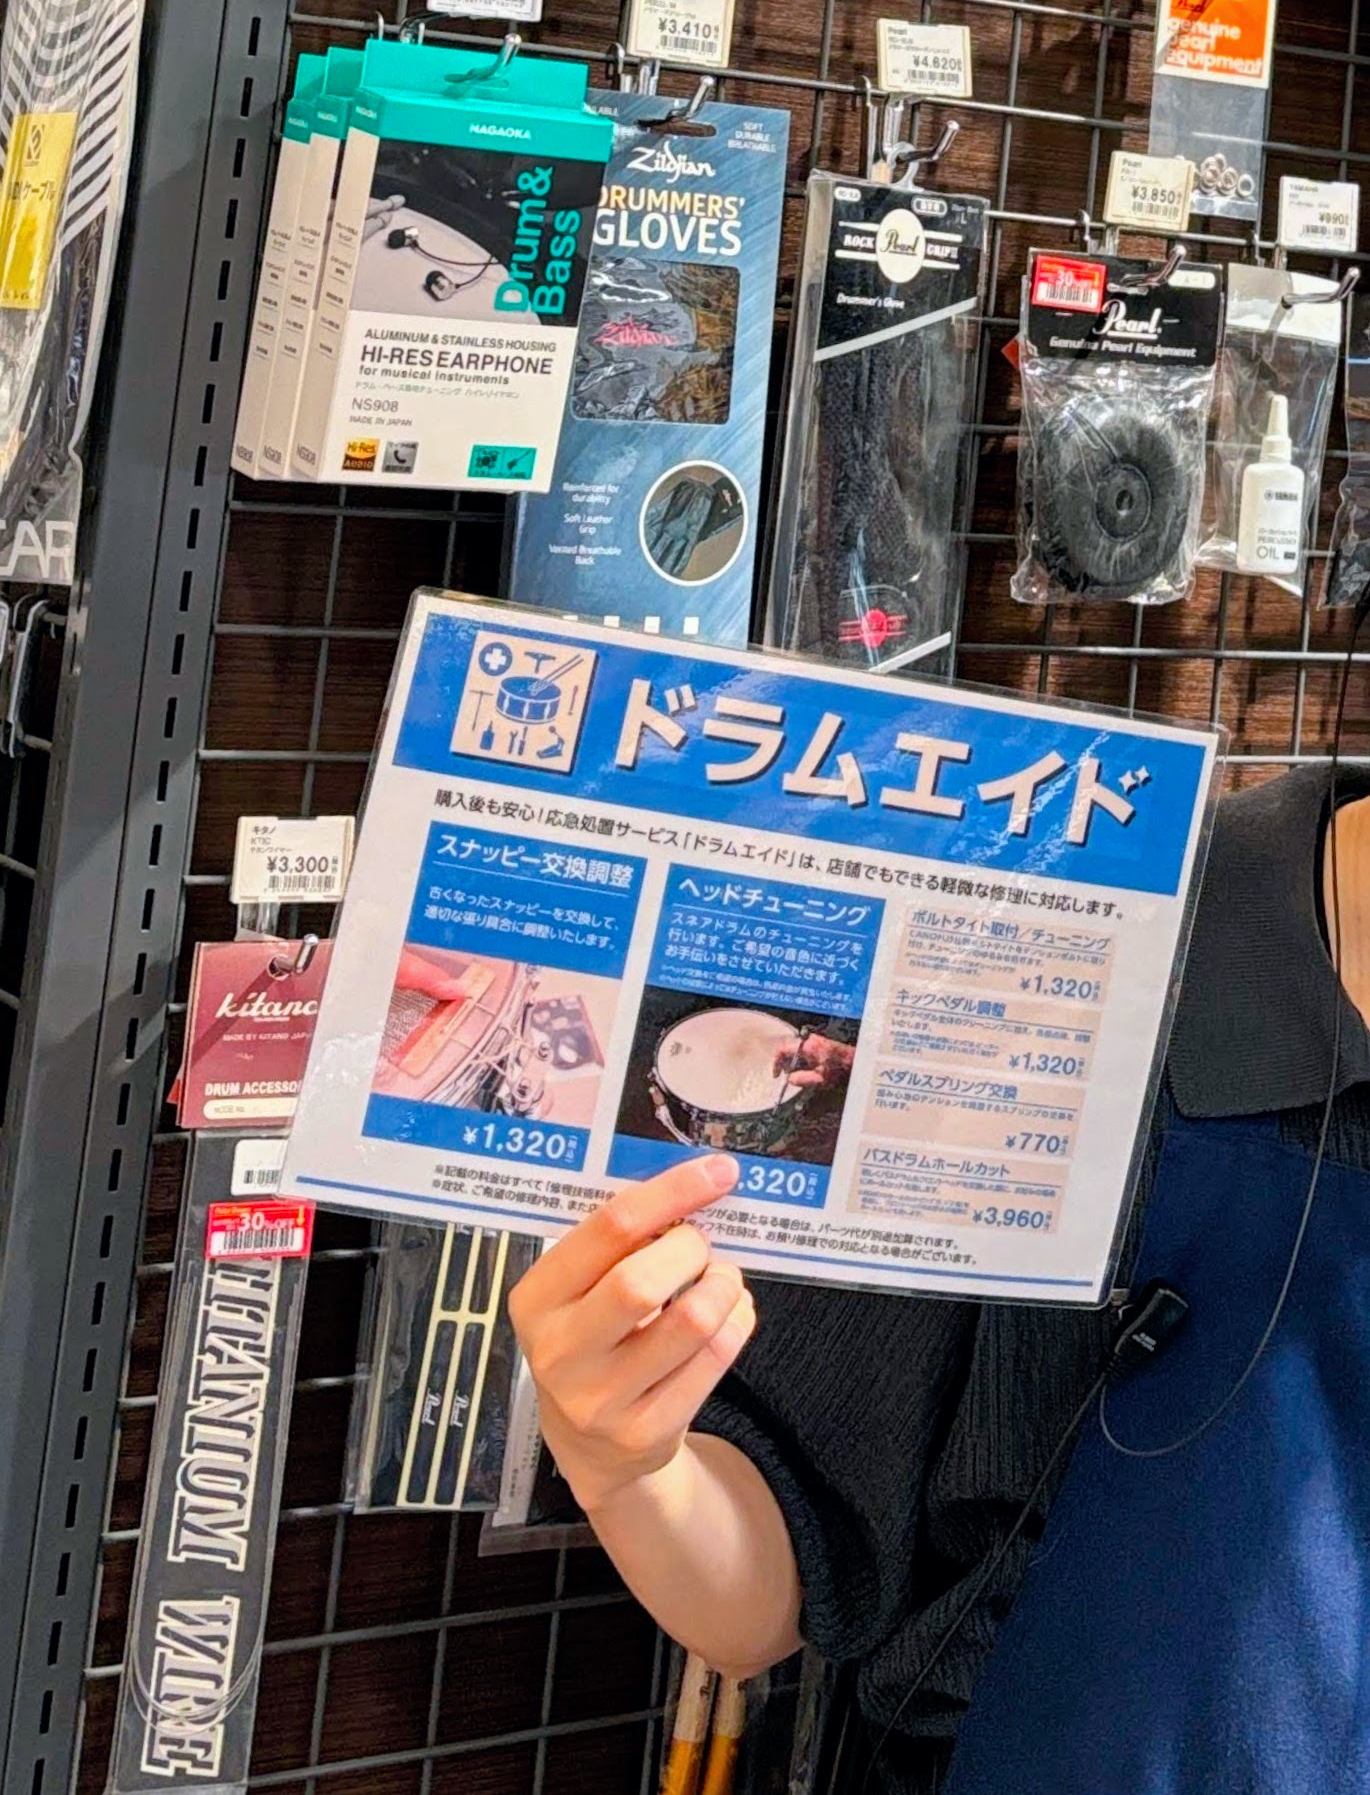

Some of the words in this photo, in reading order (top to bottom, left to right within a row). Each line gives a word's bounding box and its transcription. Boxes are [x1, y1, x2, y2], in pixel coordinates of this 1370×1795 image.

[658, 16, 712, 38] ¥3,410
[469, 122, 532, 141] NAGAOKA
[627, 140, 716, 183] Zildjian
[592, 208, 742, 257] GLOVES
[843, 233, 875, 249] ROCK
[880, 228, 918, 256] Pearl
[532, 211, 582, 316] Bass
[836, 292, 882, 307] Drummer's
[1092, 299, 1162, 334] Pearl
[364, 329, 429, 347] ALUMINUM
[441, 334, 505, 351] STAINLESS
[504, 339, 557, 353] HOUSING
[1049, 335, 1099, 352] Genuine
[1100, 339, 1134, 354] Pearl
[1135, 341, 1197, 359] Equipment
[361, 344, 435, 370] HI-RES
[437, 349, 553, 376] EARPHONE
[359, 365, 379, 379] for
[381, 367, 431, 385] musical
[435, 371, 510, 387] instruments
[352, 397, 399, 414] NS908
[349, 415, 374, 427] MADE
[386, 418, 413, 429] JAPAN
[564, 514, 580, 525] Soft
[614, 678, 1150, 846] ドラムエイド
[252, 825, 276, 835] キタノ
[267, 855, 329, 875] ¥3,300
[437, 834, 634, 889] スナッピー交換調整
[429, 886, 619, 931] 古くなったスナッピーを交換して、
[679, 878, 872, 927] ヘッドチューニング
[424, 904, 616, 950] 適切な張り具合に調整いたします。
[671, 912, 863, 955] スネアドラムのチューニングを
[665, 944, 845, 985] お手伝いをさせていただきます。
[668, 928, 859, 971] 行います。ご希望の音色に近づく
[1020, 974, 1092, 1001] ¥1,320
[896, 988, 1006, 1018] キックペダル調整
[1008, 1051, 1078, 1077] ¥1,320
[205, 1080, 239, 1096] DRUM
[242, 1079, 302, 1094] ACCESSO
[880, 1070, 1018, 1100] ペダルスプリング交換
[463, 1122, 566, 1159] ¥1,320
[1005, 1131, 1060, 1154] ¥770
[863, 1146, 1010, 1177] バスドラムホールカット
[738, 1165, 806, 1197] ,320
[238, 1211, 265, 1231] 30
[972, 1206, 1044, 1230] ¥3,960
[168, 1255, 282, 1572] TITANIUM
[140, 1596, 240, 1777] WIRE
